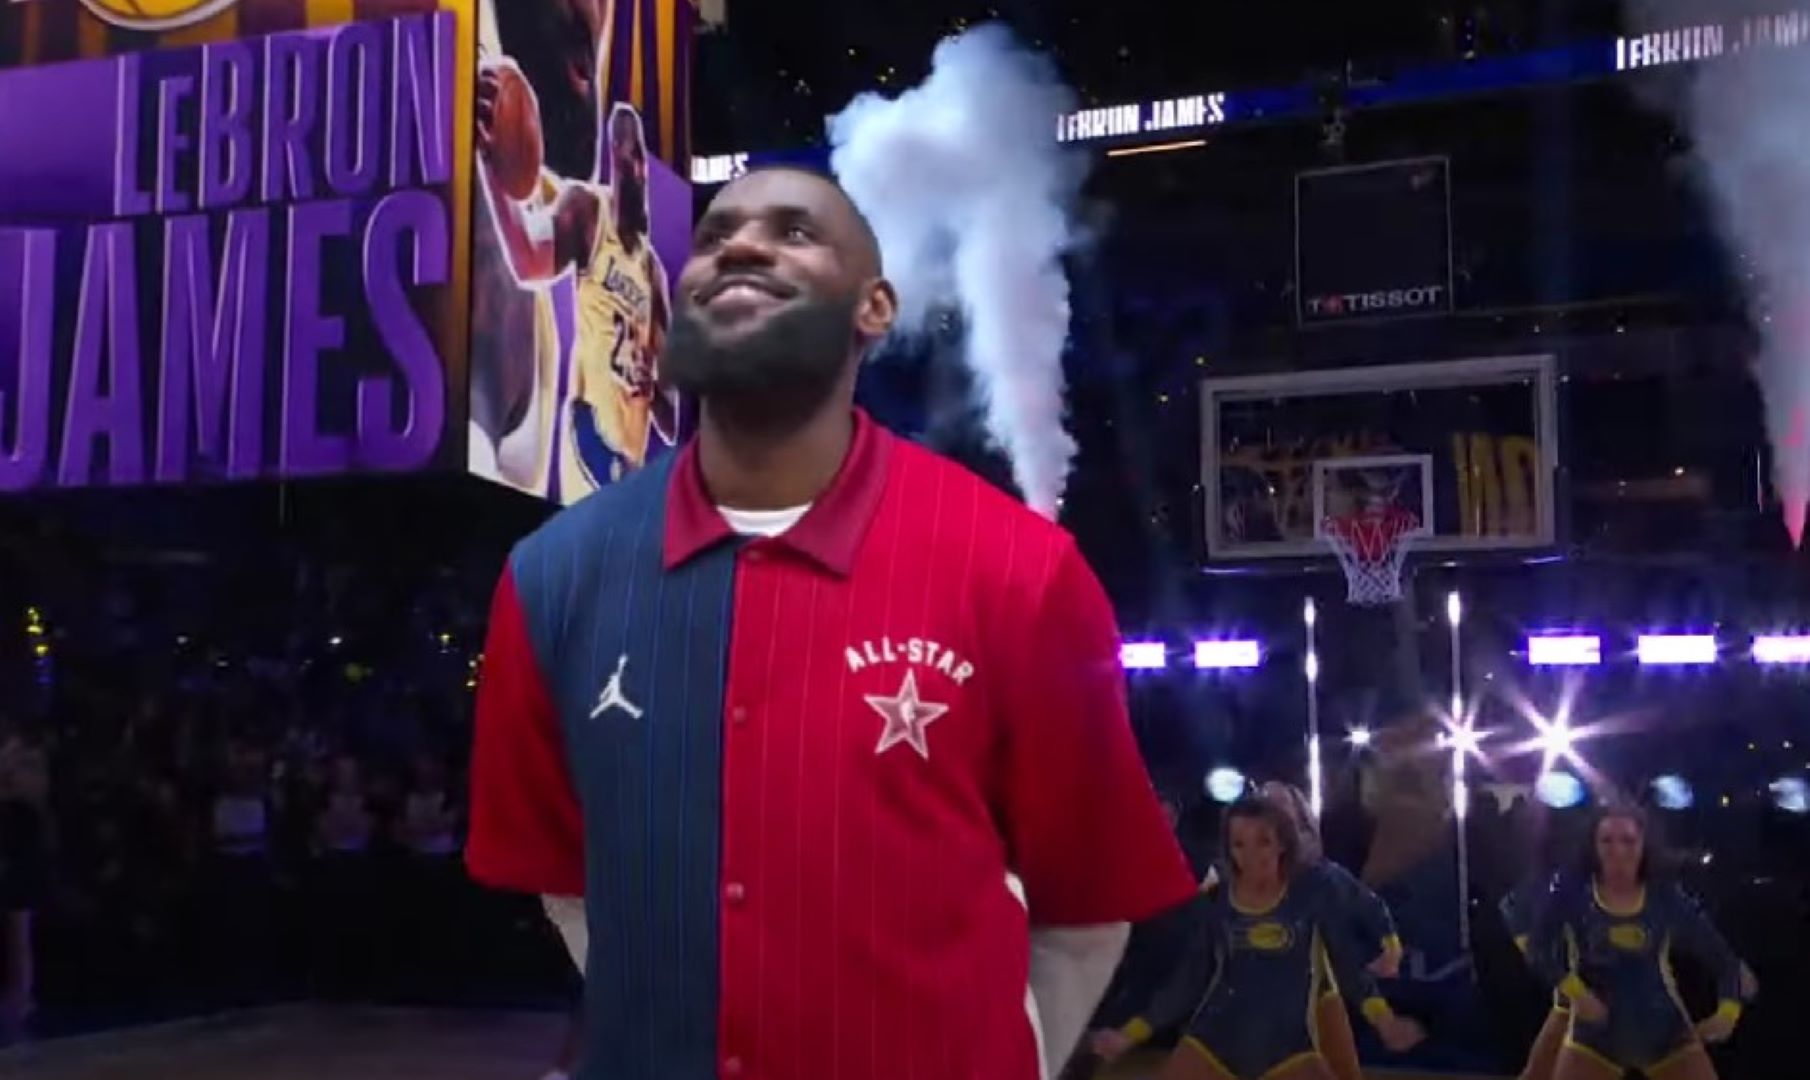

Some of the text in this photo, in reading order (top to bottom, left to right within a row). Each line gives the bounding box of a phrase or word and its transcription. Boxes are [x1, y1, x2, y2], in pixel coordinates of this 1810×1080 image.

[114, 11, 456, 216] LEBRON
[1143, 91, 1225, 131] JAMES
[691, 152, 749, 184] AMES
[0, 191, 453, 493] JAMES
[844, 636, 975, 686] ALL-STAR
